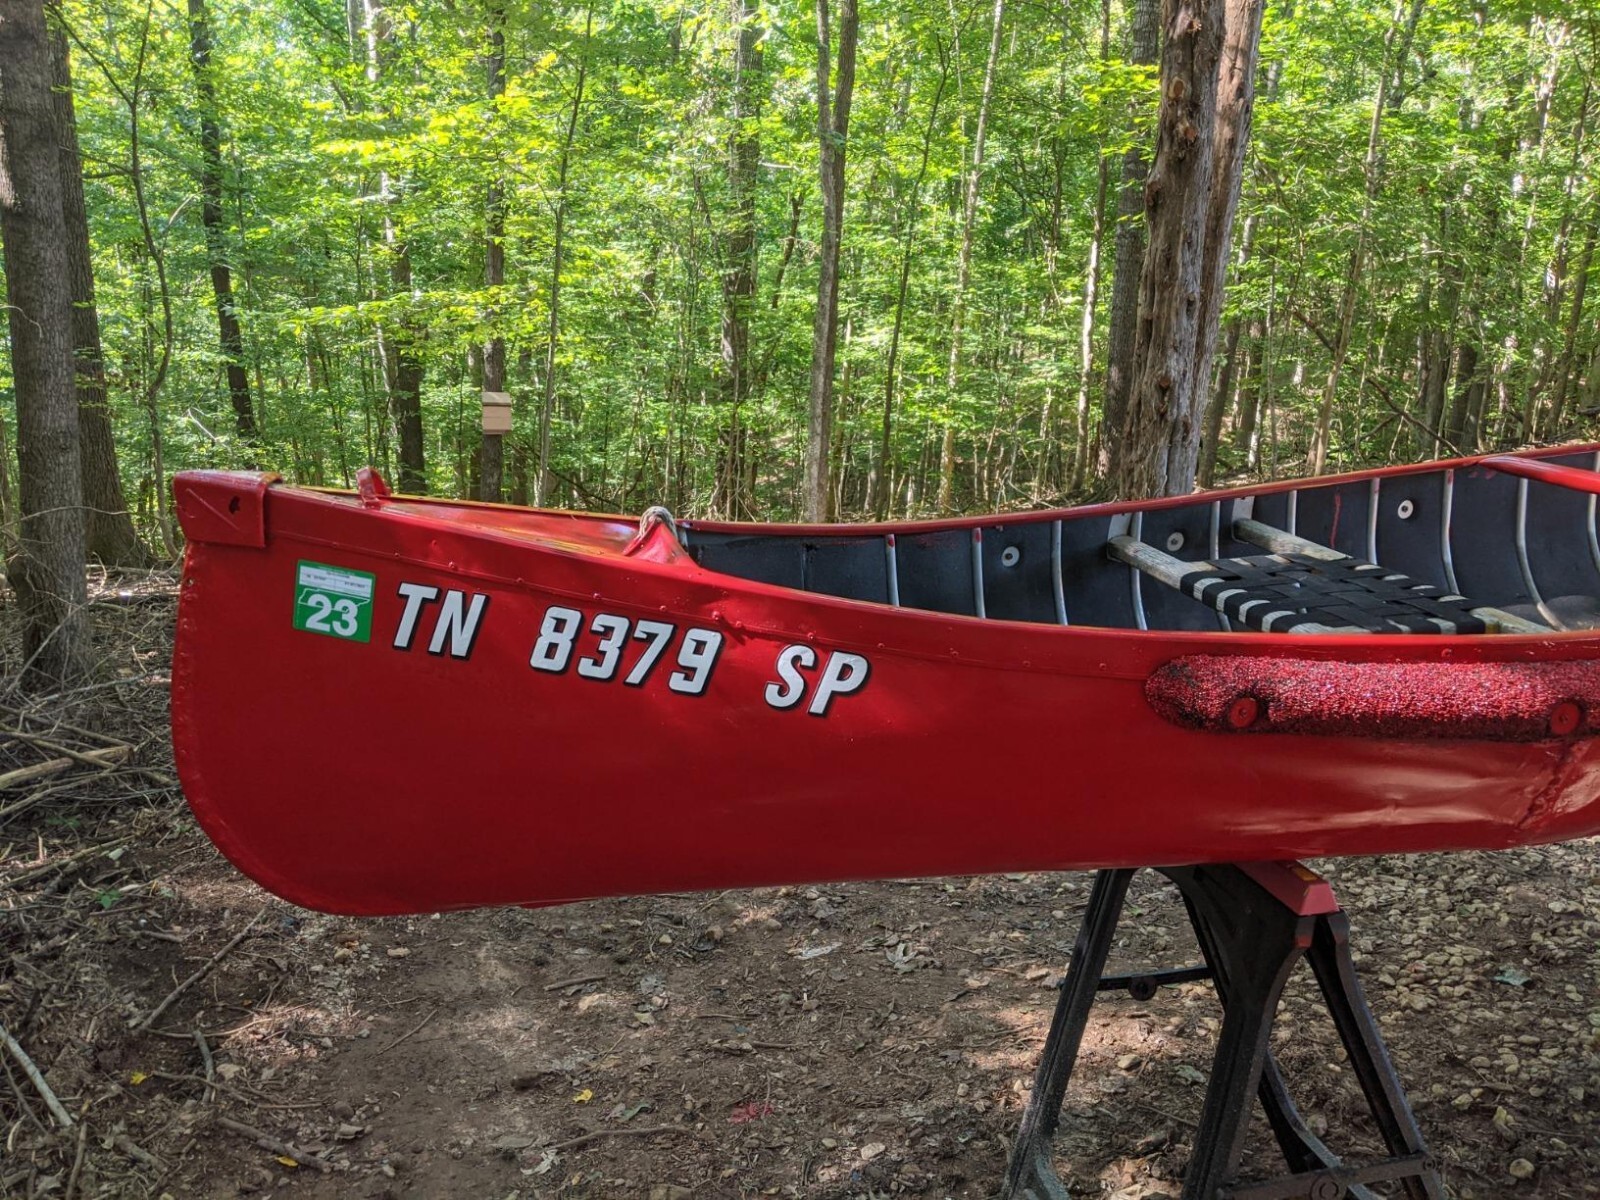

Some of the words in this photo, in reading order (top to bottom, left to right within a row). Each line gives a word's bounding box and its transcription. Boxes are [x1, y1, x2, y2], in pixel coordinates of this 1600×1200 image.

[305, 593, 358, 637] 23
[393, 583, 487, 659] TN
[529, 605, 723, 696] 8379
[764, 643, 869, 717] SP
